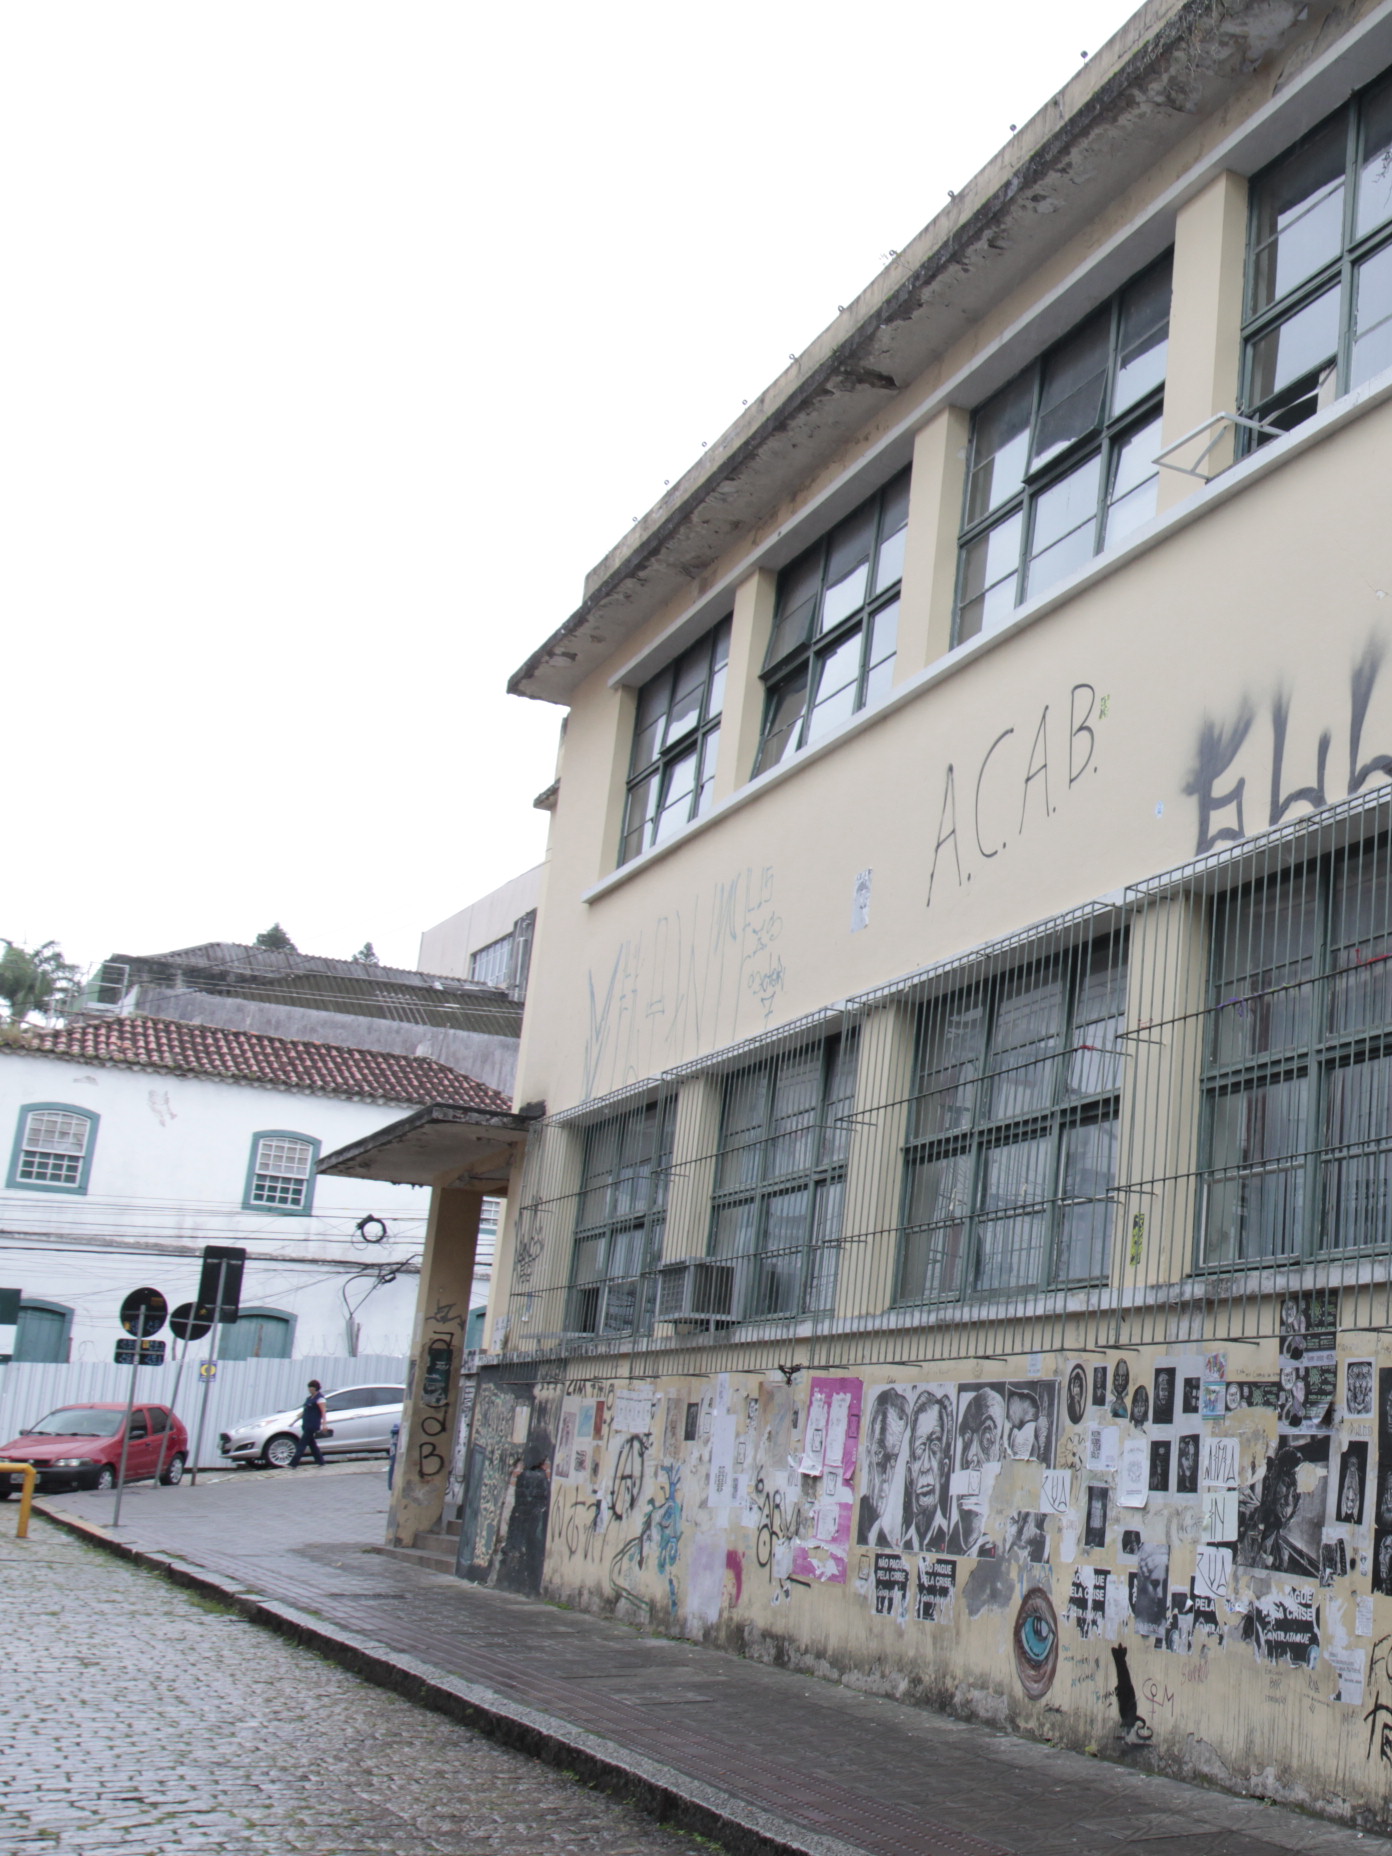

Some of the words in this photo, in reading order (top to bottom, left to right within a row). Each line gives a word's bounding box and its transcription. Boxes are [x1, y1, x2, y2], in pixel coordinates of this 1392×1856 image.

[934, 1564, 952, 1574] PAGUE
[877, 1570, 889, 1580] PELA
[890, 1572, 906, 1582] CRISE
[936, 1577, 951, 1587] CRISE
[1289, 1587, 1313, 1602] AGUE
[1194, 1599, 1215, 1612] PELA
[1286, 1606, 1313, 1620] CRISE
